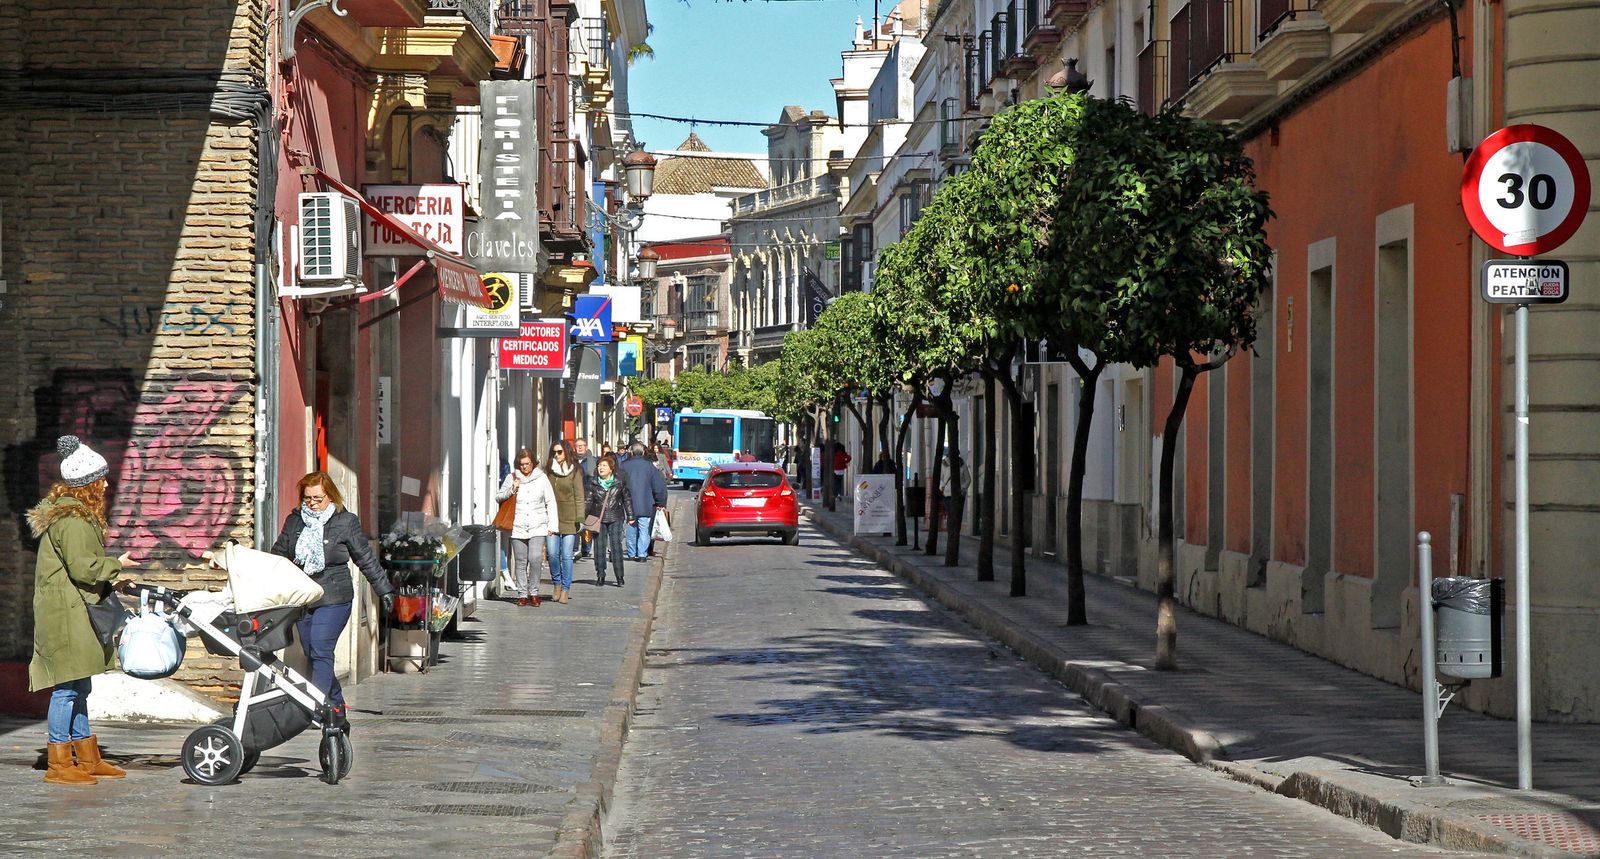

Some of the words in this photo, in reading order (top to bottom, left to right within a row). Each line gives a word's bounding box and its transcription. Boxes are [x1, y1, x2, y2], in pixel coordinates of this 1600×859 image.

[494, 95, 522, 220] FLORISTERIA
[1496, 172, 1557, 210] 30
[370, 195, 453, 215] MERCERIA
[467, 231, 534, 258] Claveles
[1493, 265, 1560, 279] ATENCIÓN
[569, 318, 605, 337] AXA
[502, 341, 560, 352] CERTIFICADOS
[512, 354, 549, 366] MEDICOS
[577, 372, 600, 380] Fiesta
